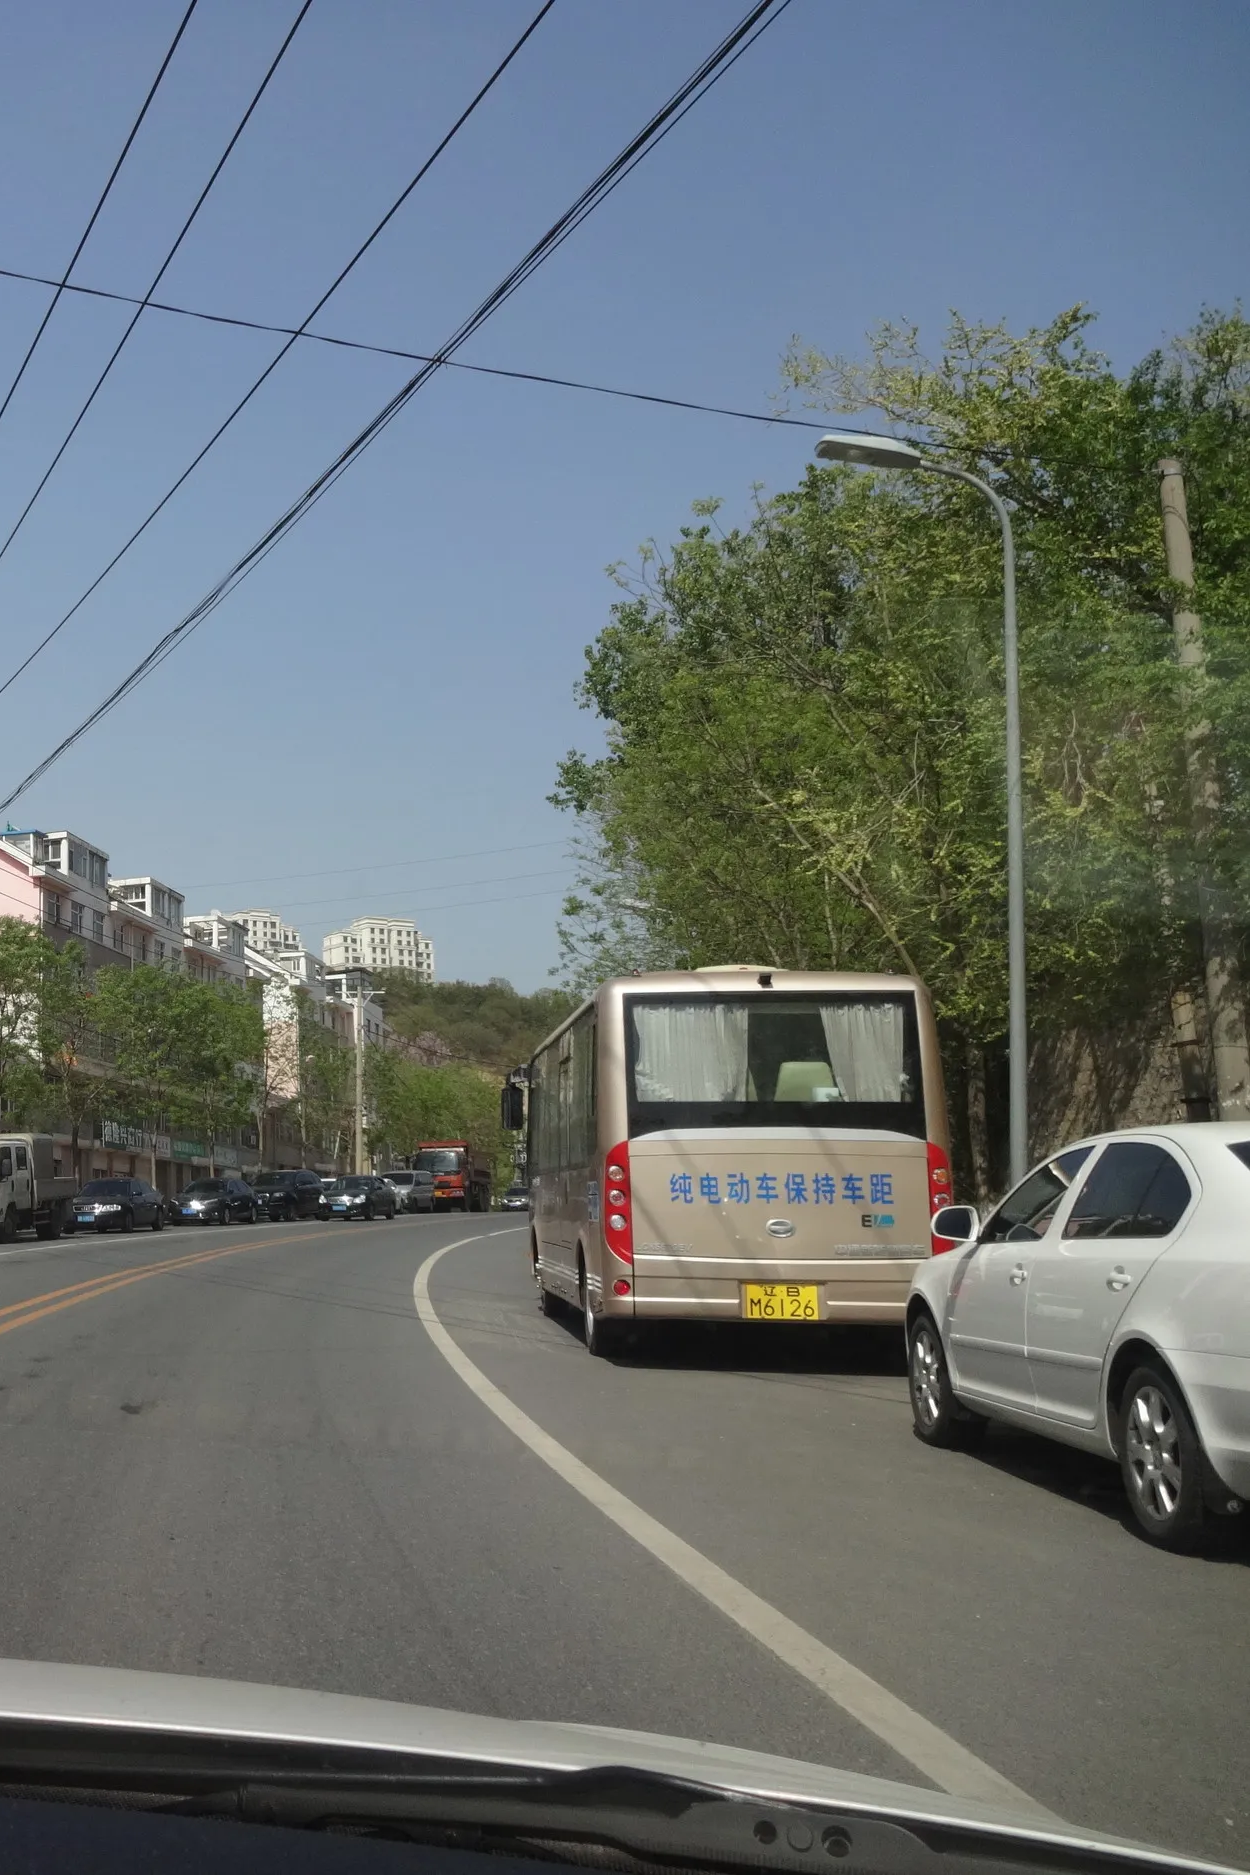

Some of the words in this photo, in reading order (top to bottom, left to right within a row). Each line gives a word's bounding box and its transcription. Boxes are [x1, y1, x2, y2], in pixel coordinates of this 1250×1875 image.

[669, 1172, 894, 1205] 纯电动车保持车距
[750, 1298, 815, 1317] M6126
